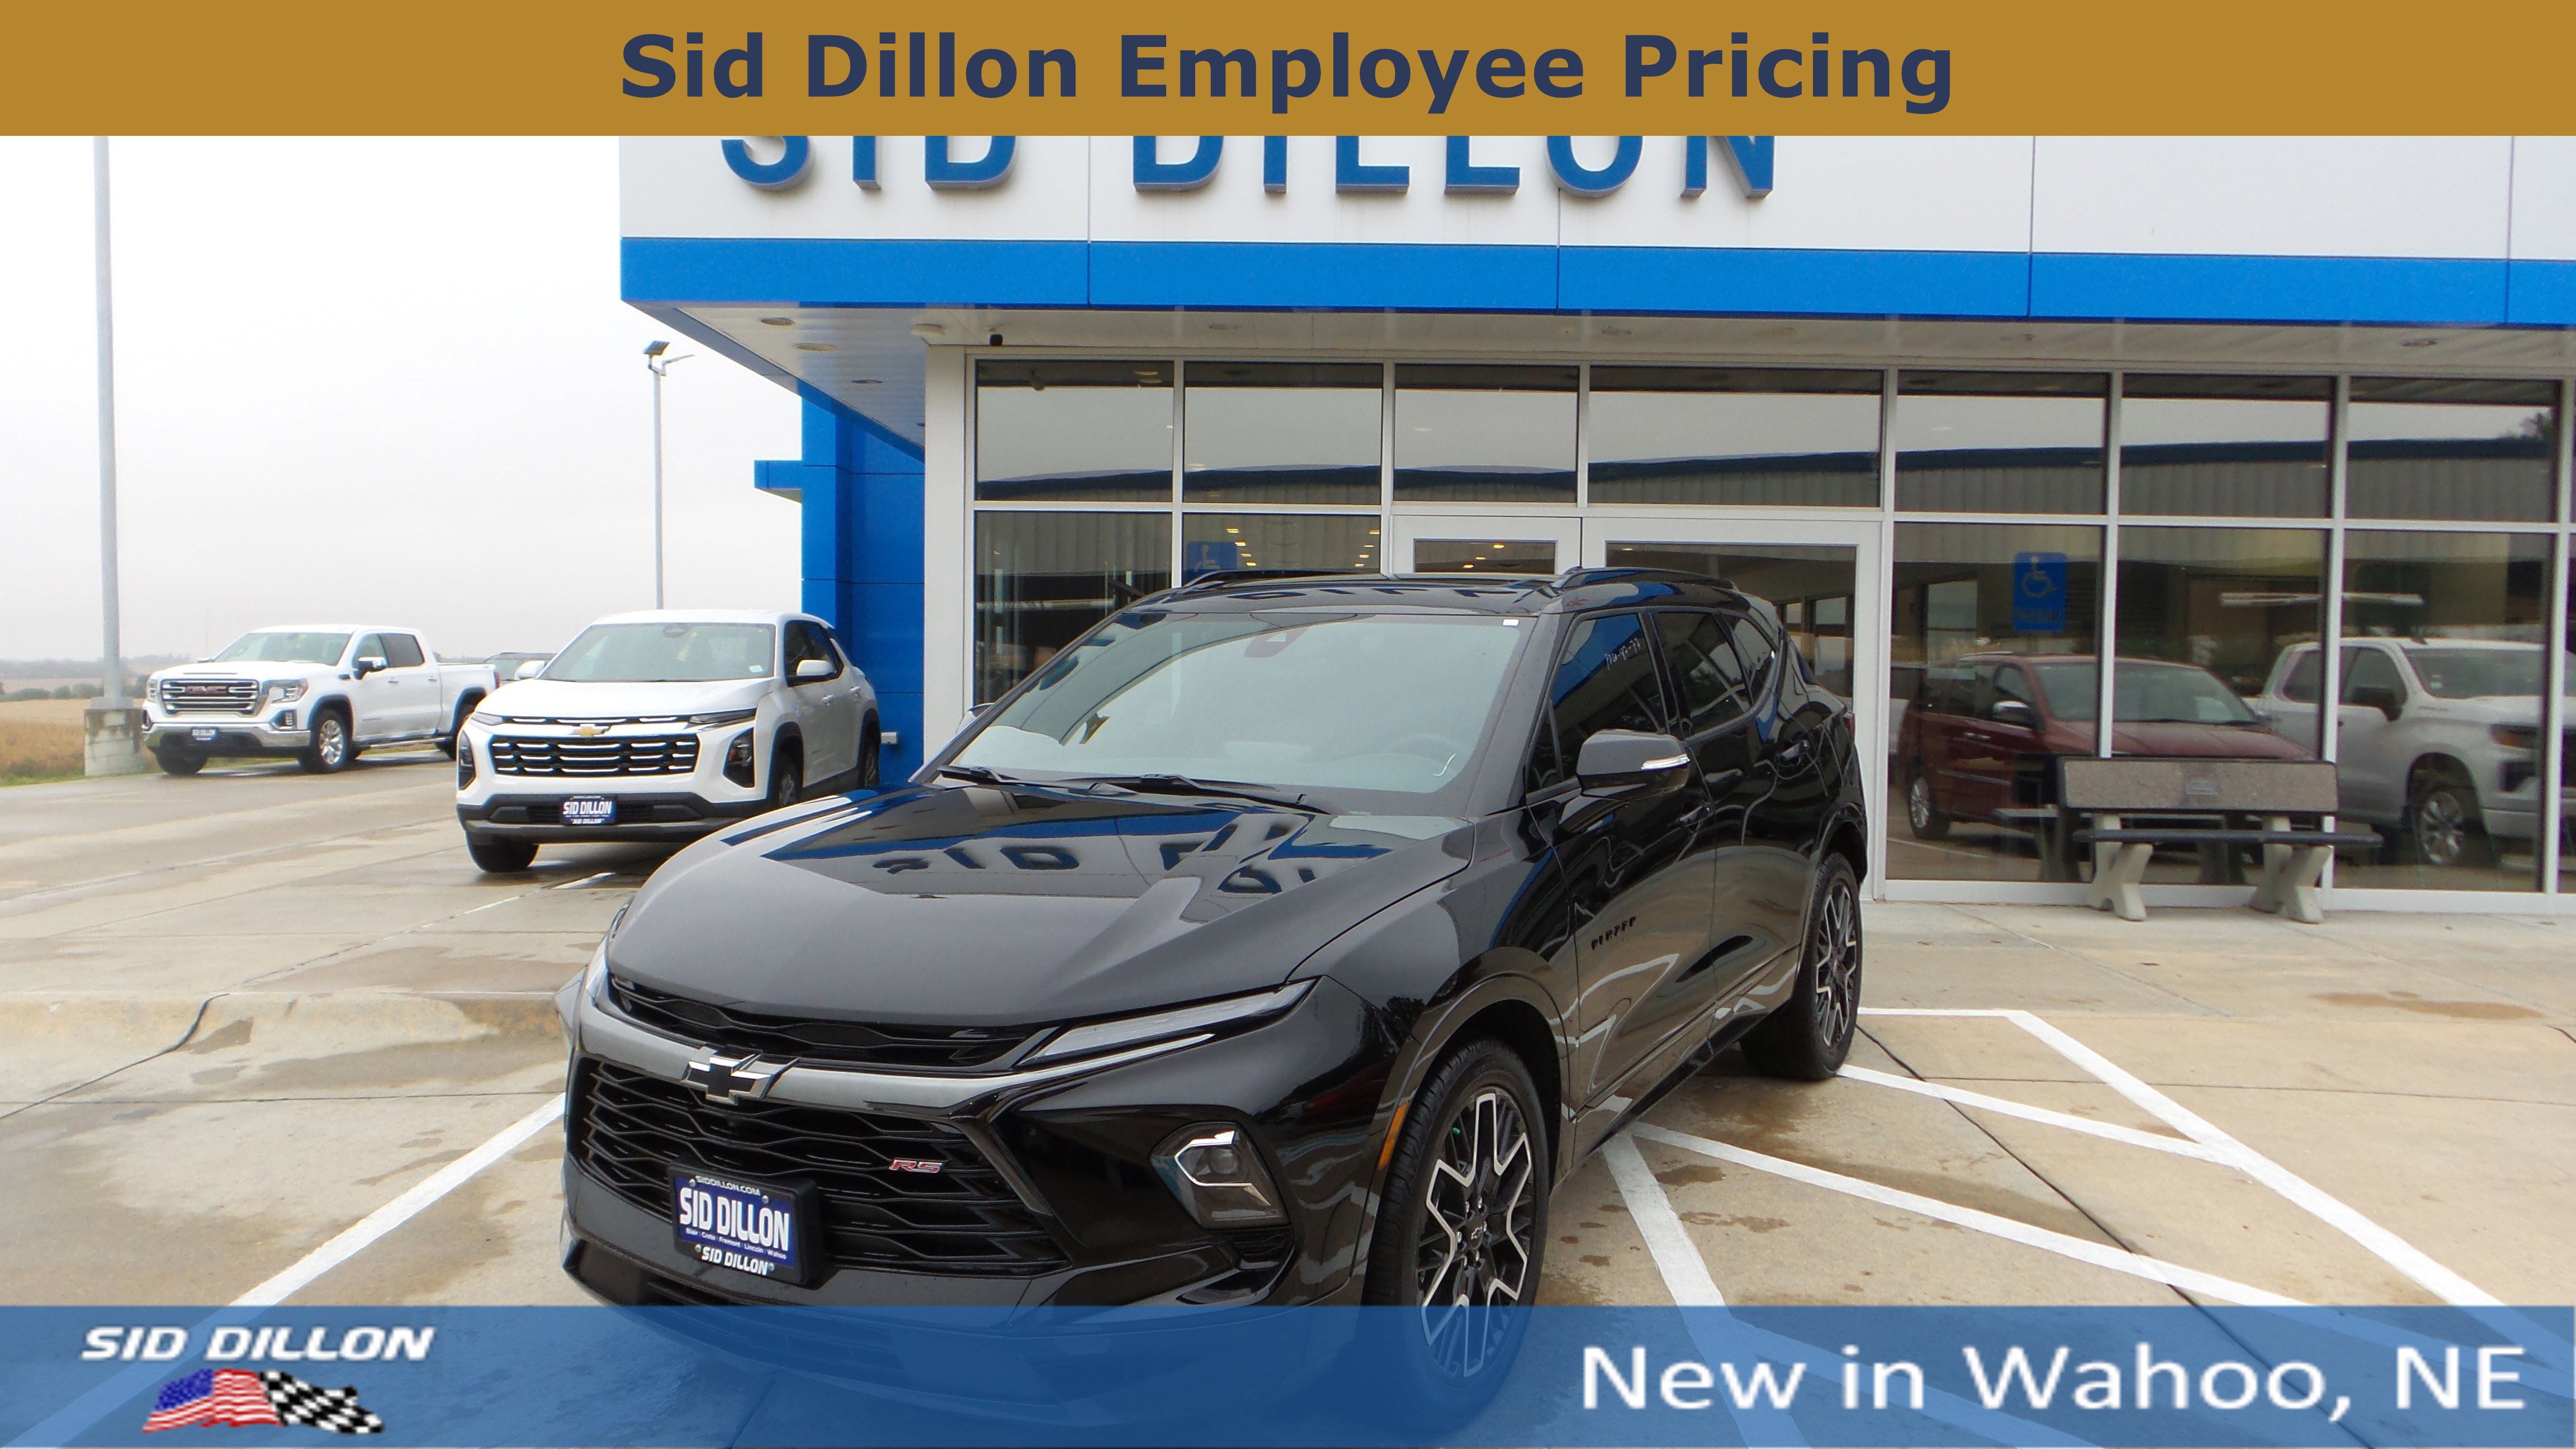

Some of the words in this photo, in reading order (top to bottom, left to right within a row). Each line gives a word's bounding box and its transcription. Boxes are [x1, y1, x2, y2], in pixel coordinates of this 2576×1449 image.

[562, 801, 579, 815] SID
[580, 801, 612, 815] DILLON
[888, 1159, 943, 1173] RS
[695, 1175, 761, 1196] SIDDILLON.COM
[680, 1187, 713, 1230] SID
[717, 1196, 789, 1252] DILLON
[702, 1246, 722, 1264] SID
[724, 1252, 769, 1276] DILLON
